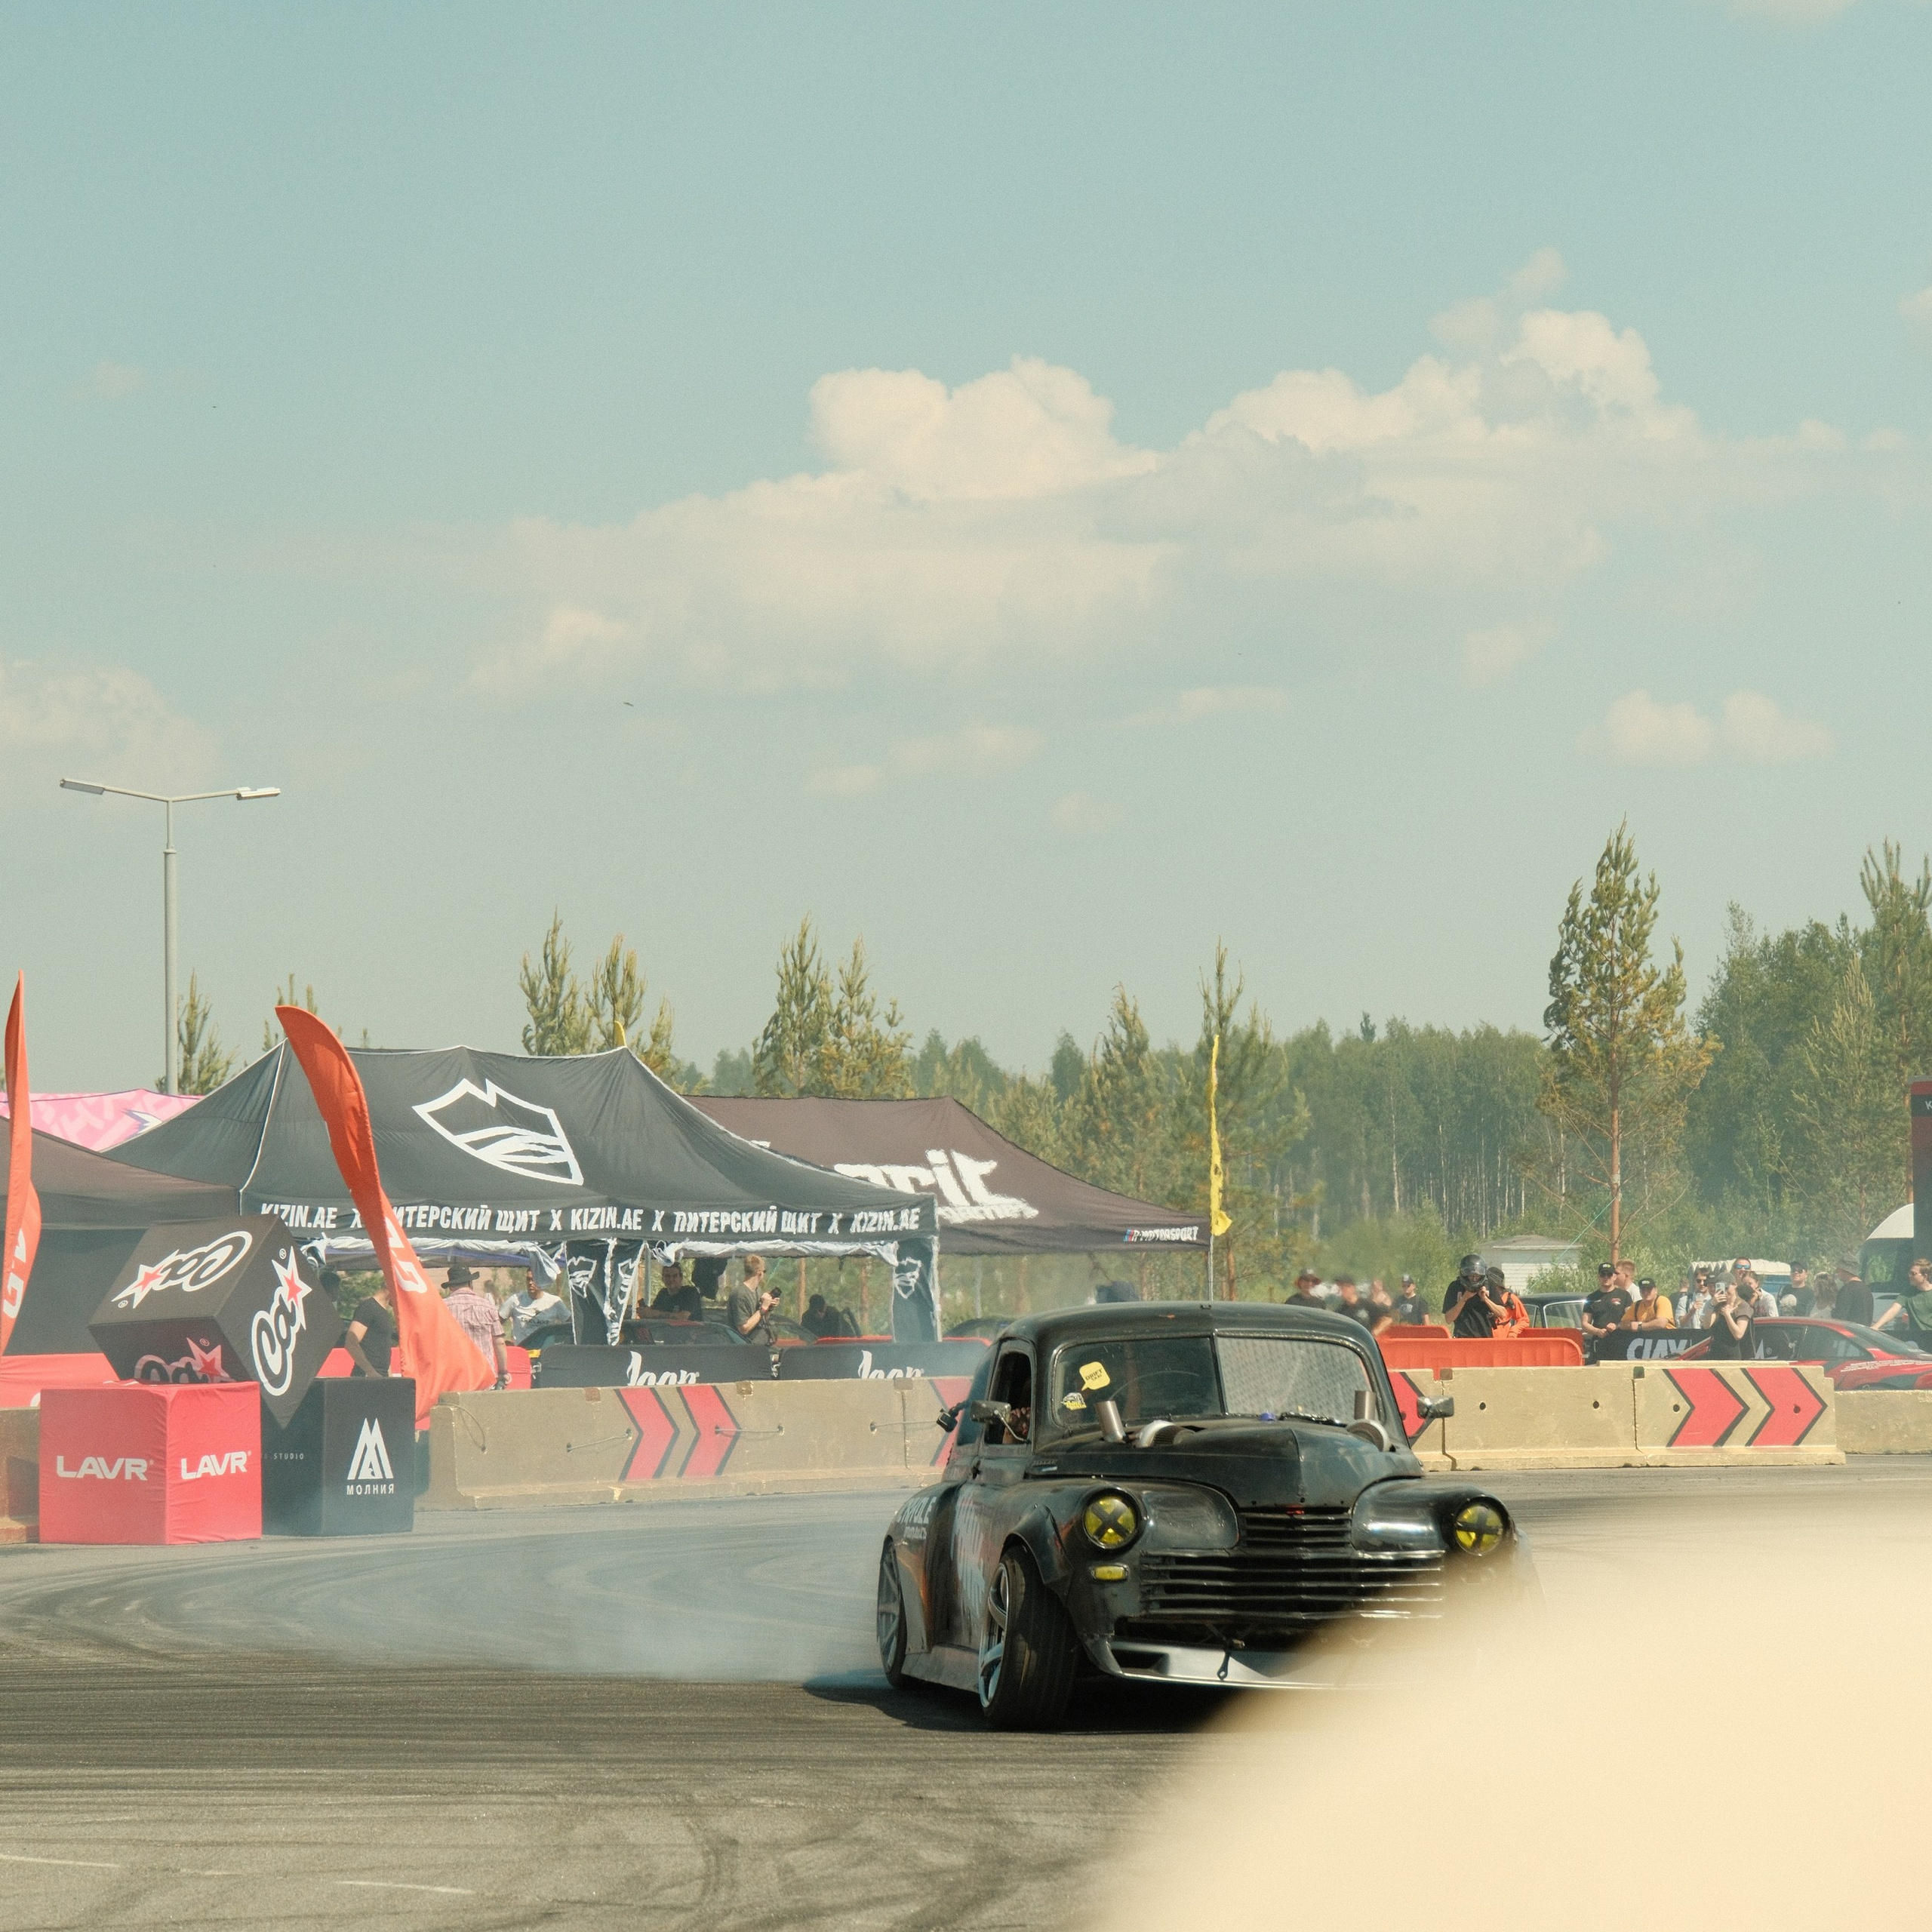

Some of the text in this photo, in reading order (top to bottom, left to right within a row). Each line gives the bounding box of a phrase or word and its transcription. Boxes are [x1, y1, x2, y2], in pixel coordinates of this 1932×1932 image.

[392, 1204, 490, 1231] ИТЕРСКИЙ
[495, 1210, 540, 1234] ЩИТ
[571, 1207, 644, 1231] KIZIN.AE
[673, 1205, 777, 1233] ПИТЕРСКИЙ
[780, 1211, 822, 1235] ЩИТ
[850, 1208, 921, 1234] KIZIN.AE
[1085, 1368, 1103, 1380] DRIFT
[57, 1455, 148, 1481] LAVR
[181, 1451, 248, 1480] LAVR
[346, 1483, 395, 1495] МОЛНИЯ
